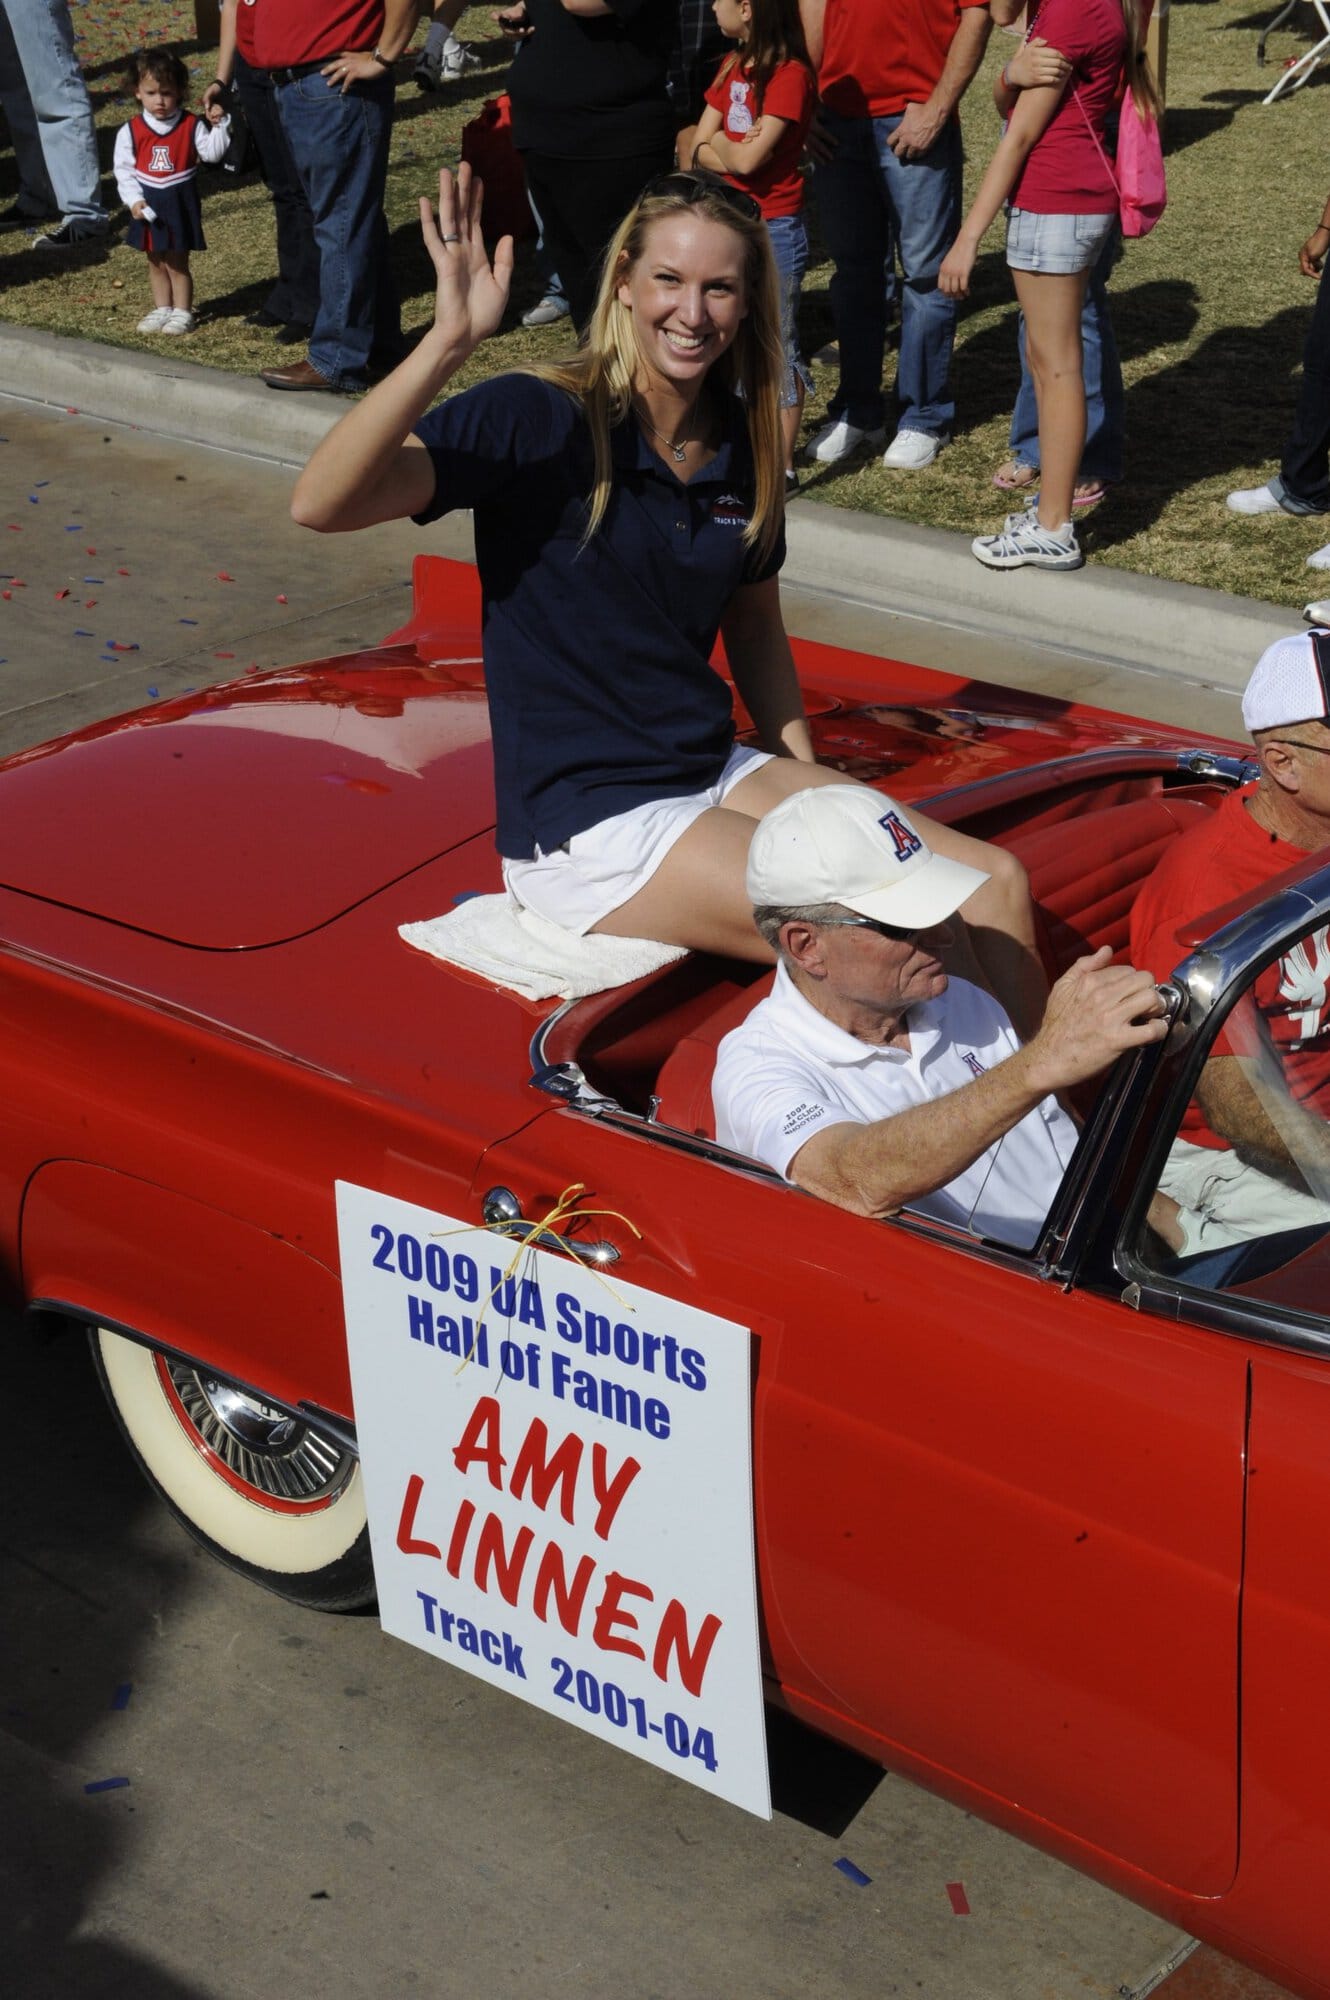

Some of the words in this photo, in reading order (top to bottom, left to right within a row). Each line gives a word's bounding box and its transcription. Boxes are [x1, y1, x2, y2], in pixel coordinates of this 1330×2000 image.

[149, 146, 174, 171] A
[713, 516, 731, 525] TRACK
[878, 811, 923, 863] A
[961, 1051, 988, 1078] A
[783, 1119, 797, 1131] JIM
[797, 1104, 821, 1121] CLICK
[786, 1103, 807, 1120] 2009
[371, 1224, 479, 1303] 2009
[490, 1263, 546, 1331] UA
[555, 1292, 707, 1391] Sports
[407, 1295, 489, 1368] Hall
[500, 1340, 541, 1389] of
[552, 1351, 671, 1440] Fame
[453, 1396, 641, 1541] AMY
[396, 1474, 722, 1697] LINNEN
[416, 1592, 526, 1679] Track
[550, 1657, 719, 1772] 2001-04
